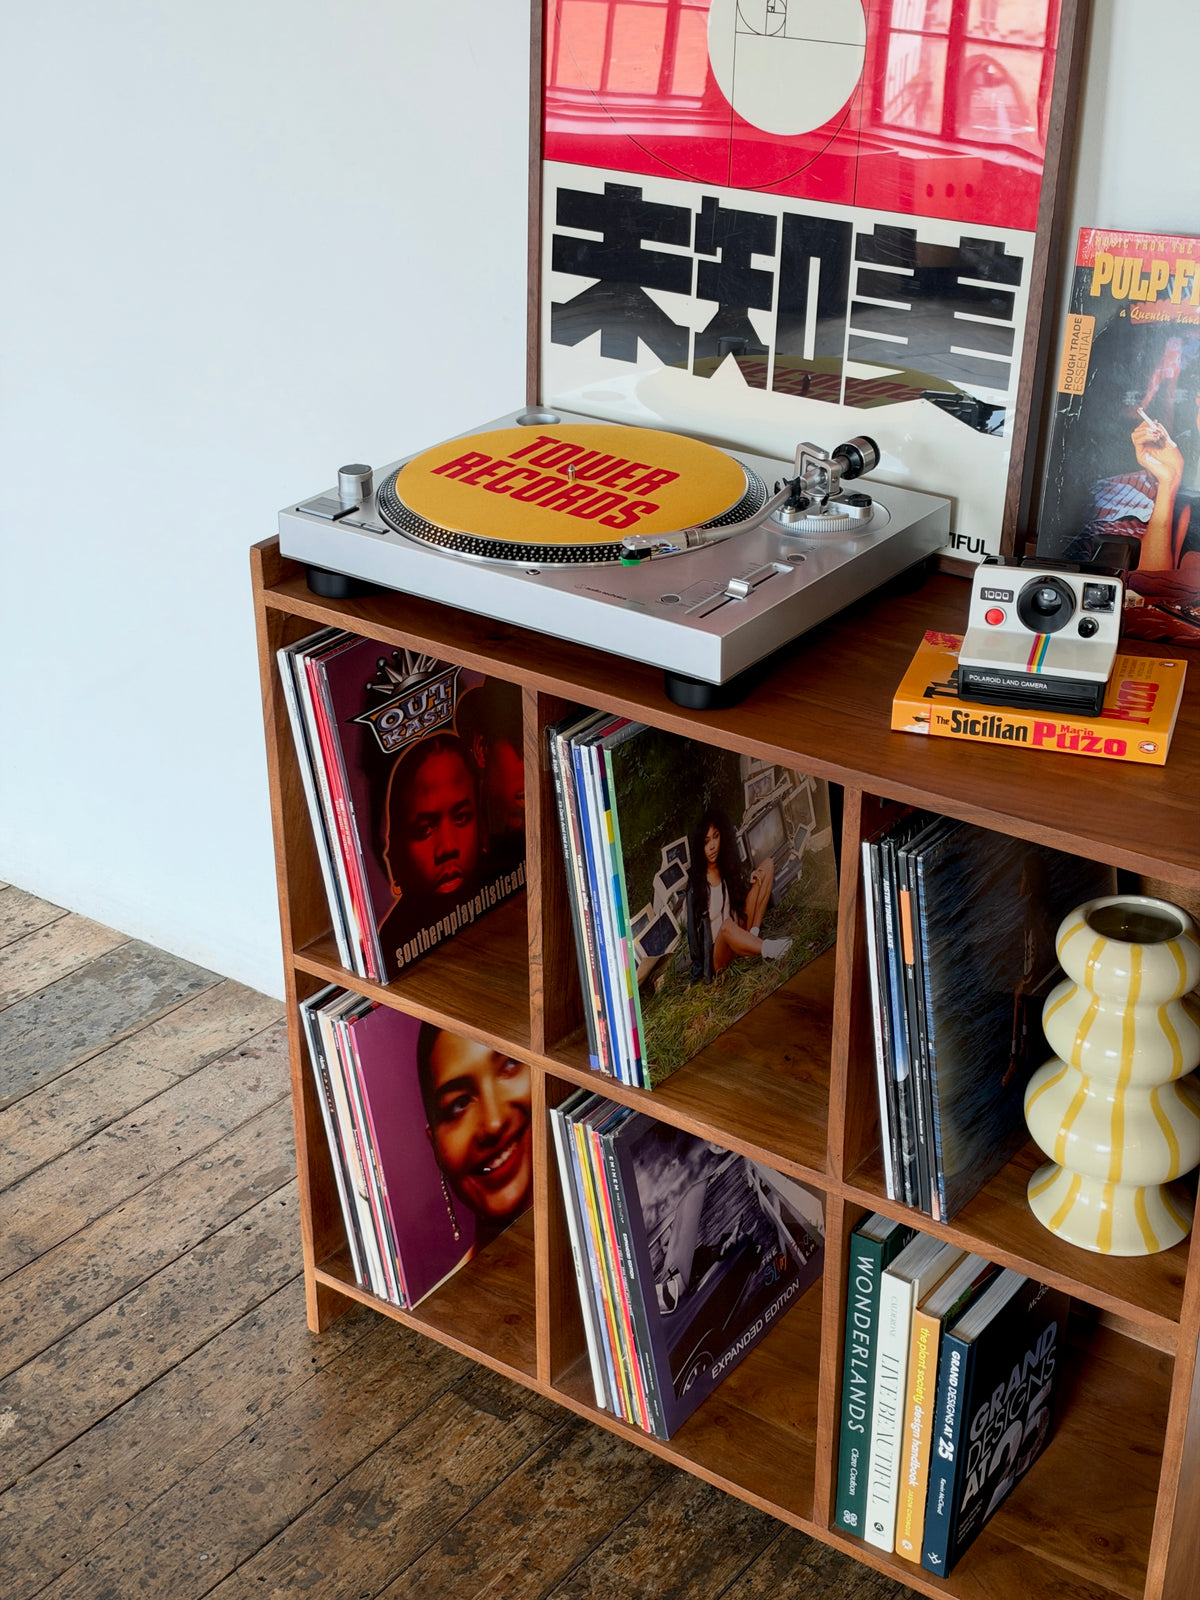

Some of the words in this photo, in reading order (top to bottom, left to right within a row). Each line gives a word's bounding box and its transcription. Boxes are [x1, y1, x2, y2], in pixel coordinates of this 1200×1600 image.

[1135, 241, 1165, 253] FROM
[1172, 243, 1194, 255] THE
[1090, 252, 1169, 302] PULP
[1130, 306, 1170, 322] Quentin
[1064, 353, 1076, 390] ROUGH
[1070, 317, 1083, 351] TRADE
[1073, 327, 1092, 392] ESSENTIAL
[507, 435, 681, 497] TOWER
[430, 451, 661, 530] RECORDS
[984, 589, 1010, 601] 1000
[968, 674, 1001, 685] POLAROID
[1002, 678, 1020, 687] LAND
[1021, 681, 1048, 690] CAMERA
[377, 678, 451, 732] OUT
[382, 702, 450, 748] KAST
[936, 714, 950, 727] The
[951, 709, 1028, 743] Sicilian
[1032, 720, 1127, 757] Puzo
[1060, 723, 1094, 737] Mario
[883, 878, 892, 904] JUSTIN
[885, 904, 894, 949] TIMBERLAKE
[608, 1156, 620, 1191] EMINEM
[764, 1278, 800, 1323] EDITION
[848, 1255, 875, 1434] WONDERLANDS
[920, 1328, 931, 1343] the
[917, 1341, 930, 1370] plant
[949, 1350, 961, 1387] GRAND
[879, 1353, 900, 1402] LIVE
[912, 1369, 926, 1405] society
[970, 1321, 1057, 1442] GRAND
[911, 1405, 925, 1438] design
[944, 1386, 957, 1426] DESIGNS
[966, 1345, 1056, 1479] DESIGNS
[938, 1436, 955, 1462] 25
[943, 1424, 953, 1439] AT
[960, 1450, 991, 1513] AT
[982, 1377, 1053, 1524] 25
[872, 1403, 897, 1504] BEAUTIFUL
[908, 1438, 923, 1487] handbook
[848, 1466, 859, 1496] Coulson
